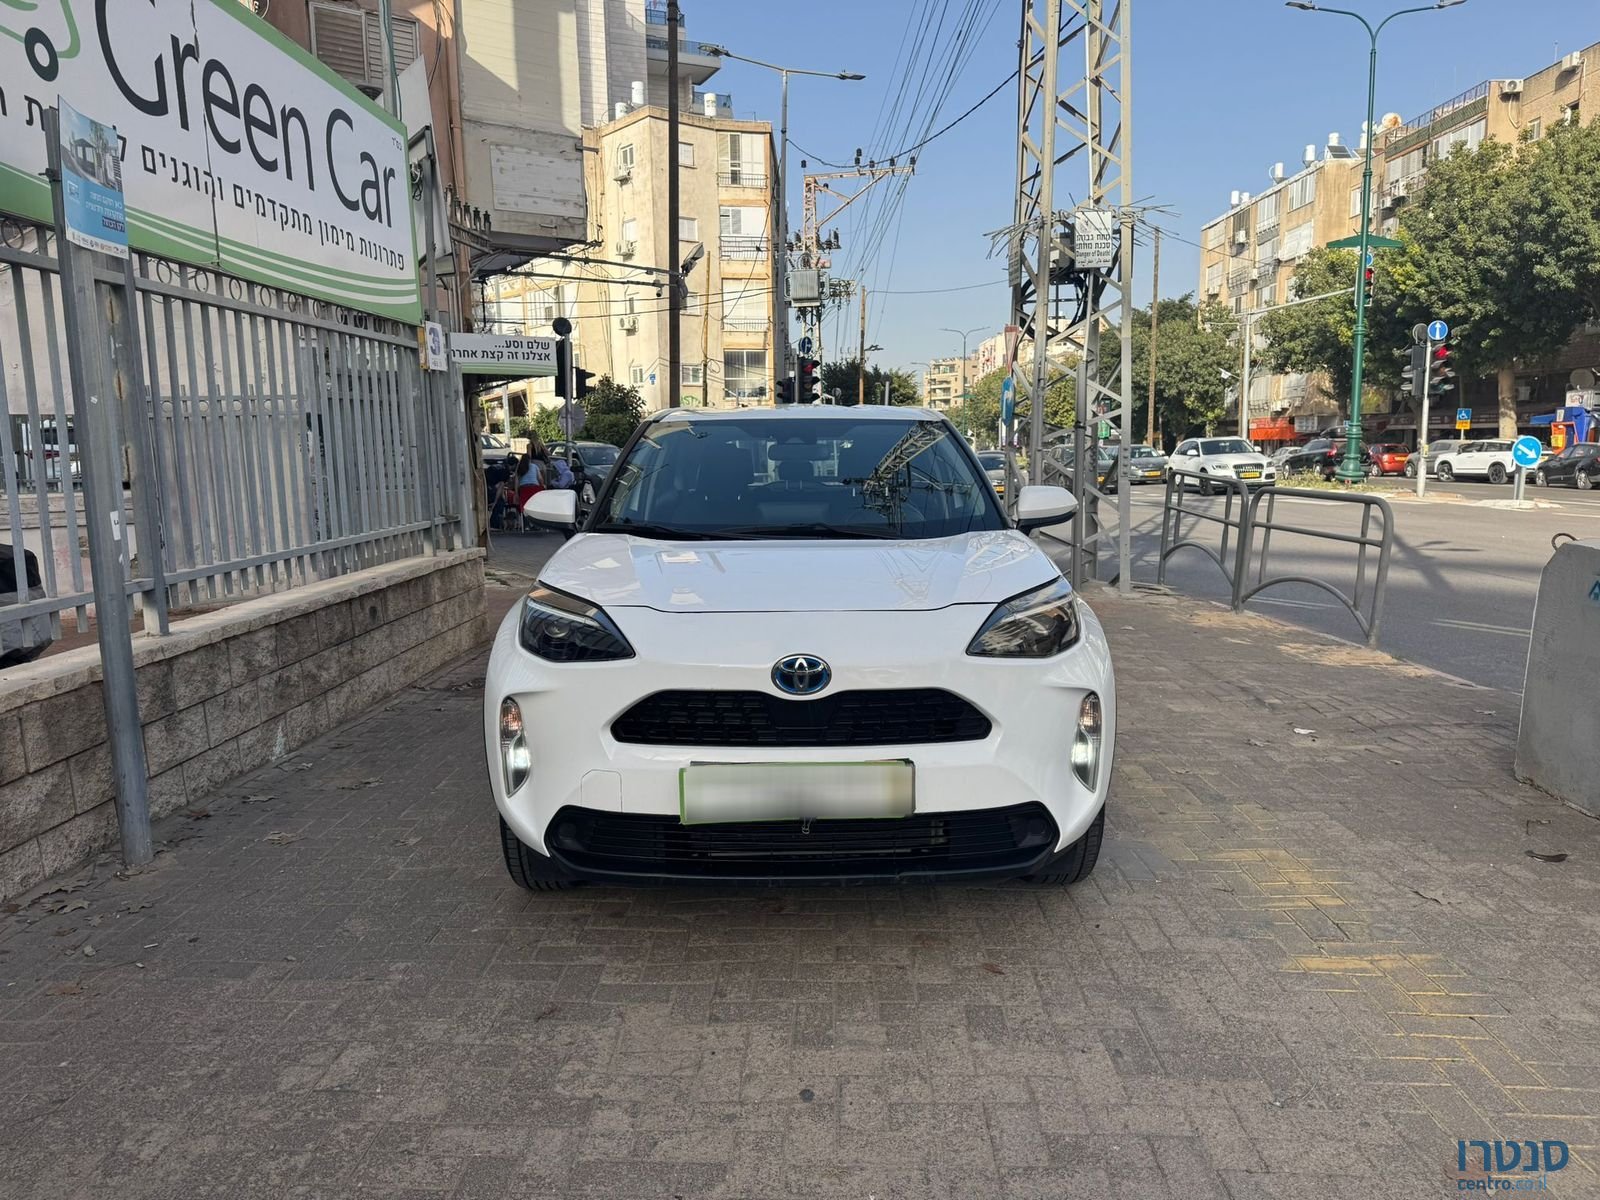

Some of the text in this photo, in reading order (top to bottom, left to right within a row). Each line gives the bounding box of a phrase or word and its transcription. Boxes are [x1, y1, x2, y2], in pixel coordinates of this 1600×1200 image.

[95, 0, 315, 191] Green
[326, 108, 396, 228] Car
[142, 146, 405, 271] פתרונות מימון מתקדמים והוגנים
[1076, 250, 1091, 258] Danger
[494, 339, 550, 350] שלם וסע...
[481, 350, 504, 362] קצת
[507, 351, 519, 360] זה
[522, 351, 551, 361] אצלנו
